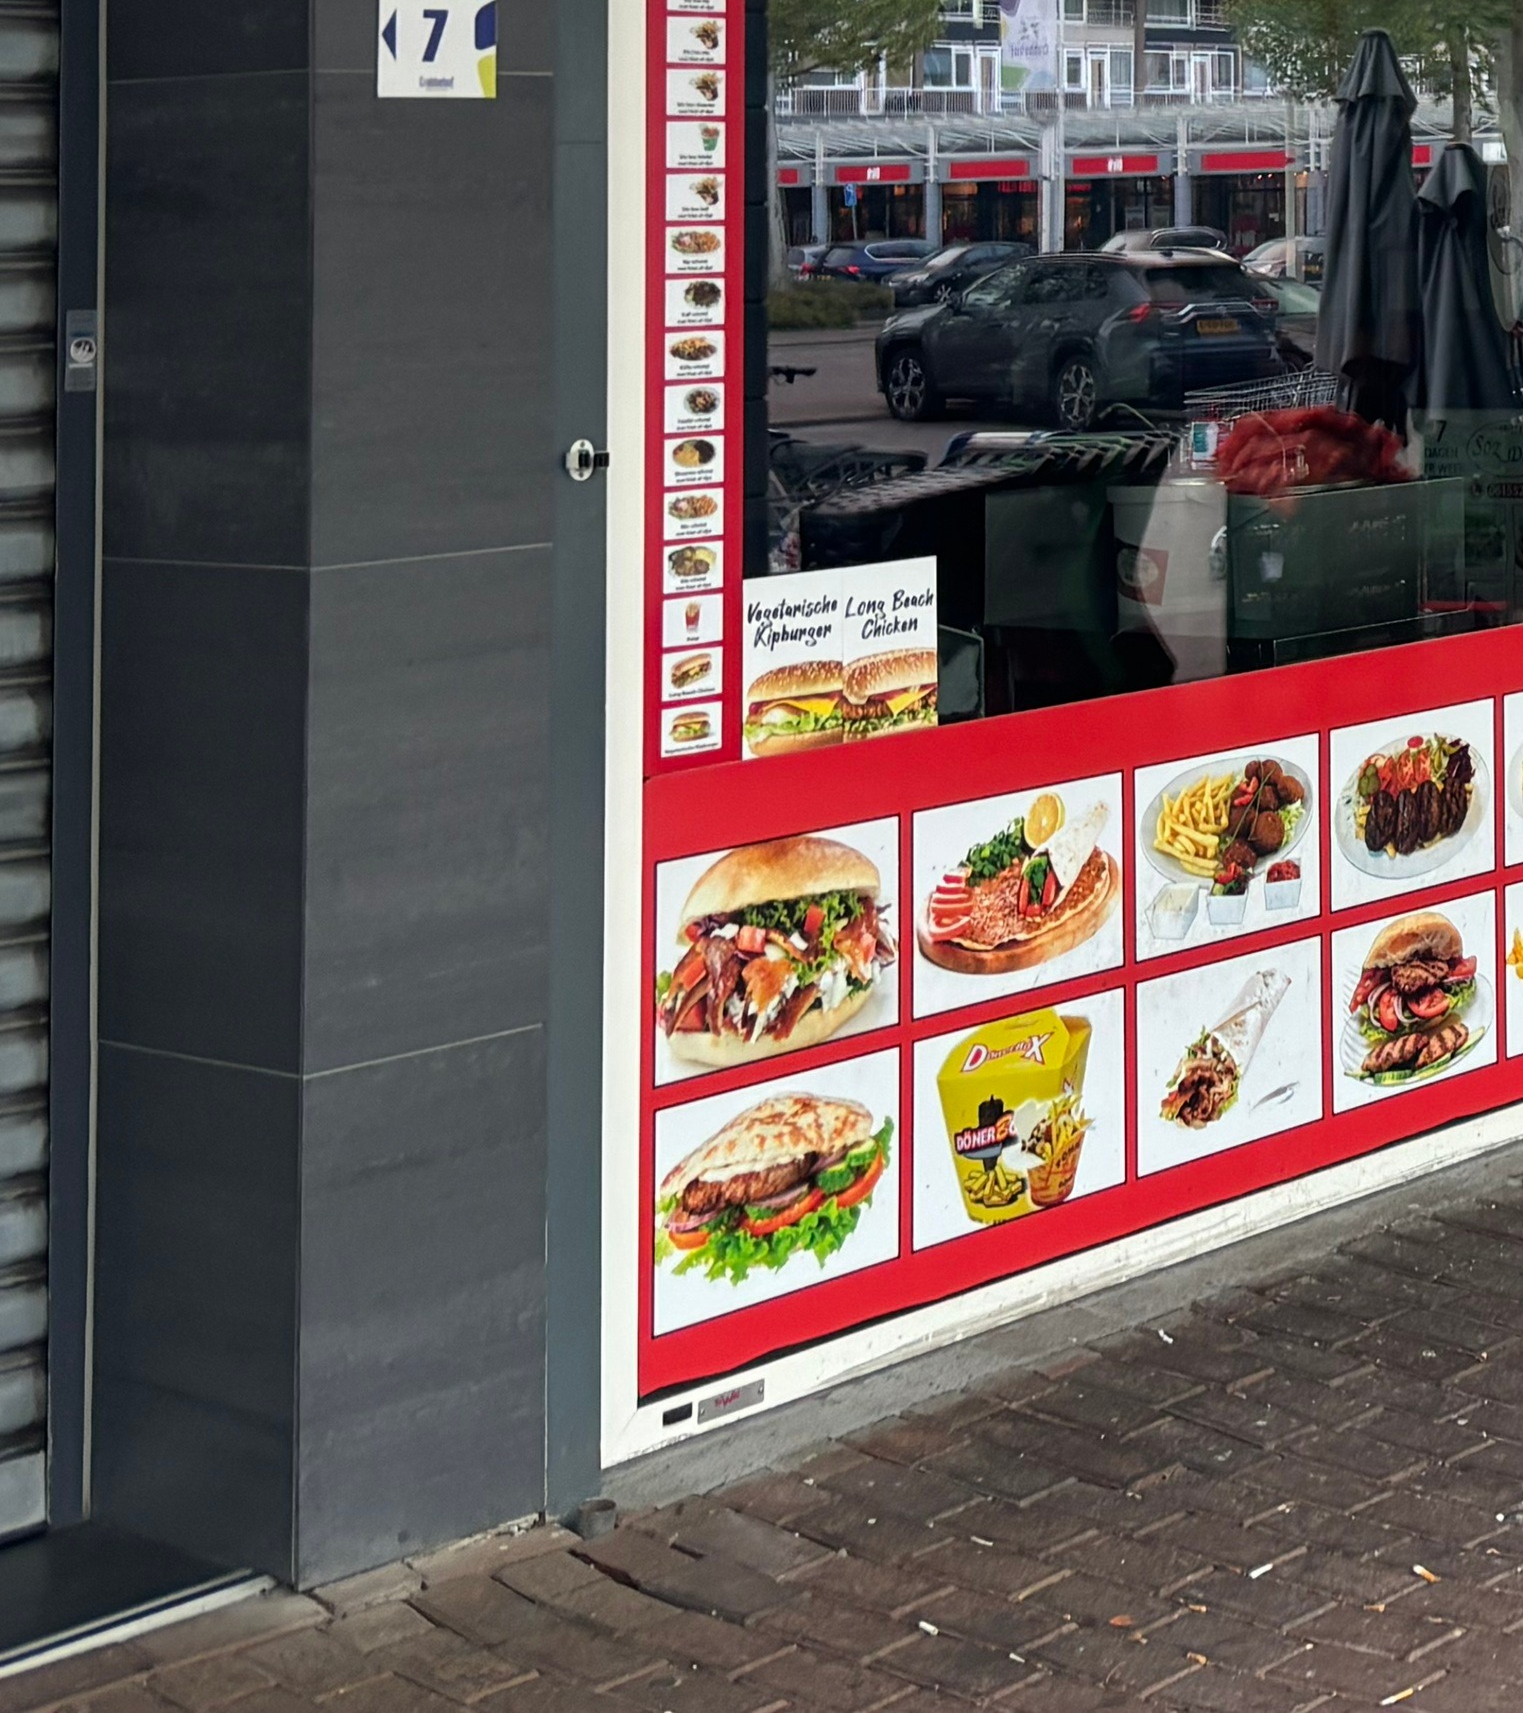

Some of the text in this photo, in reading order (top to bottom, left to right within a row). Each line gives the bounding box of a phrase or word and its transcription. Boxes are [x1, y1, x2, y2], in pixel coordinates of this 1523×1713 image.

[422, 9, 449, 62] 7
[747, 595, 838, 628] Vegetarische
[845, 588, 934, 621] Long Beach
[753, 623, 832, 652] Kipburger
[861, 617, 919, 640] Chicken
[956, 1126, 996, 1152] DÖNER
